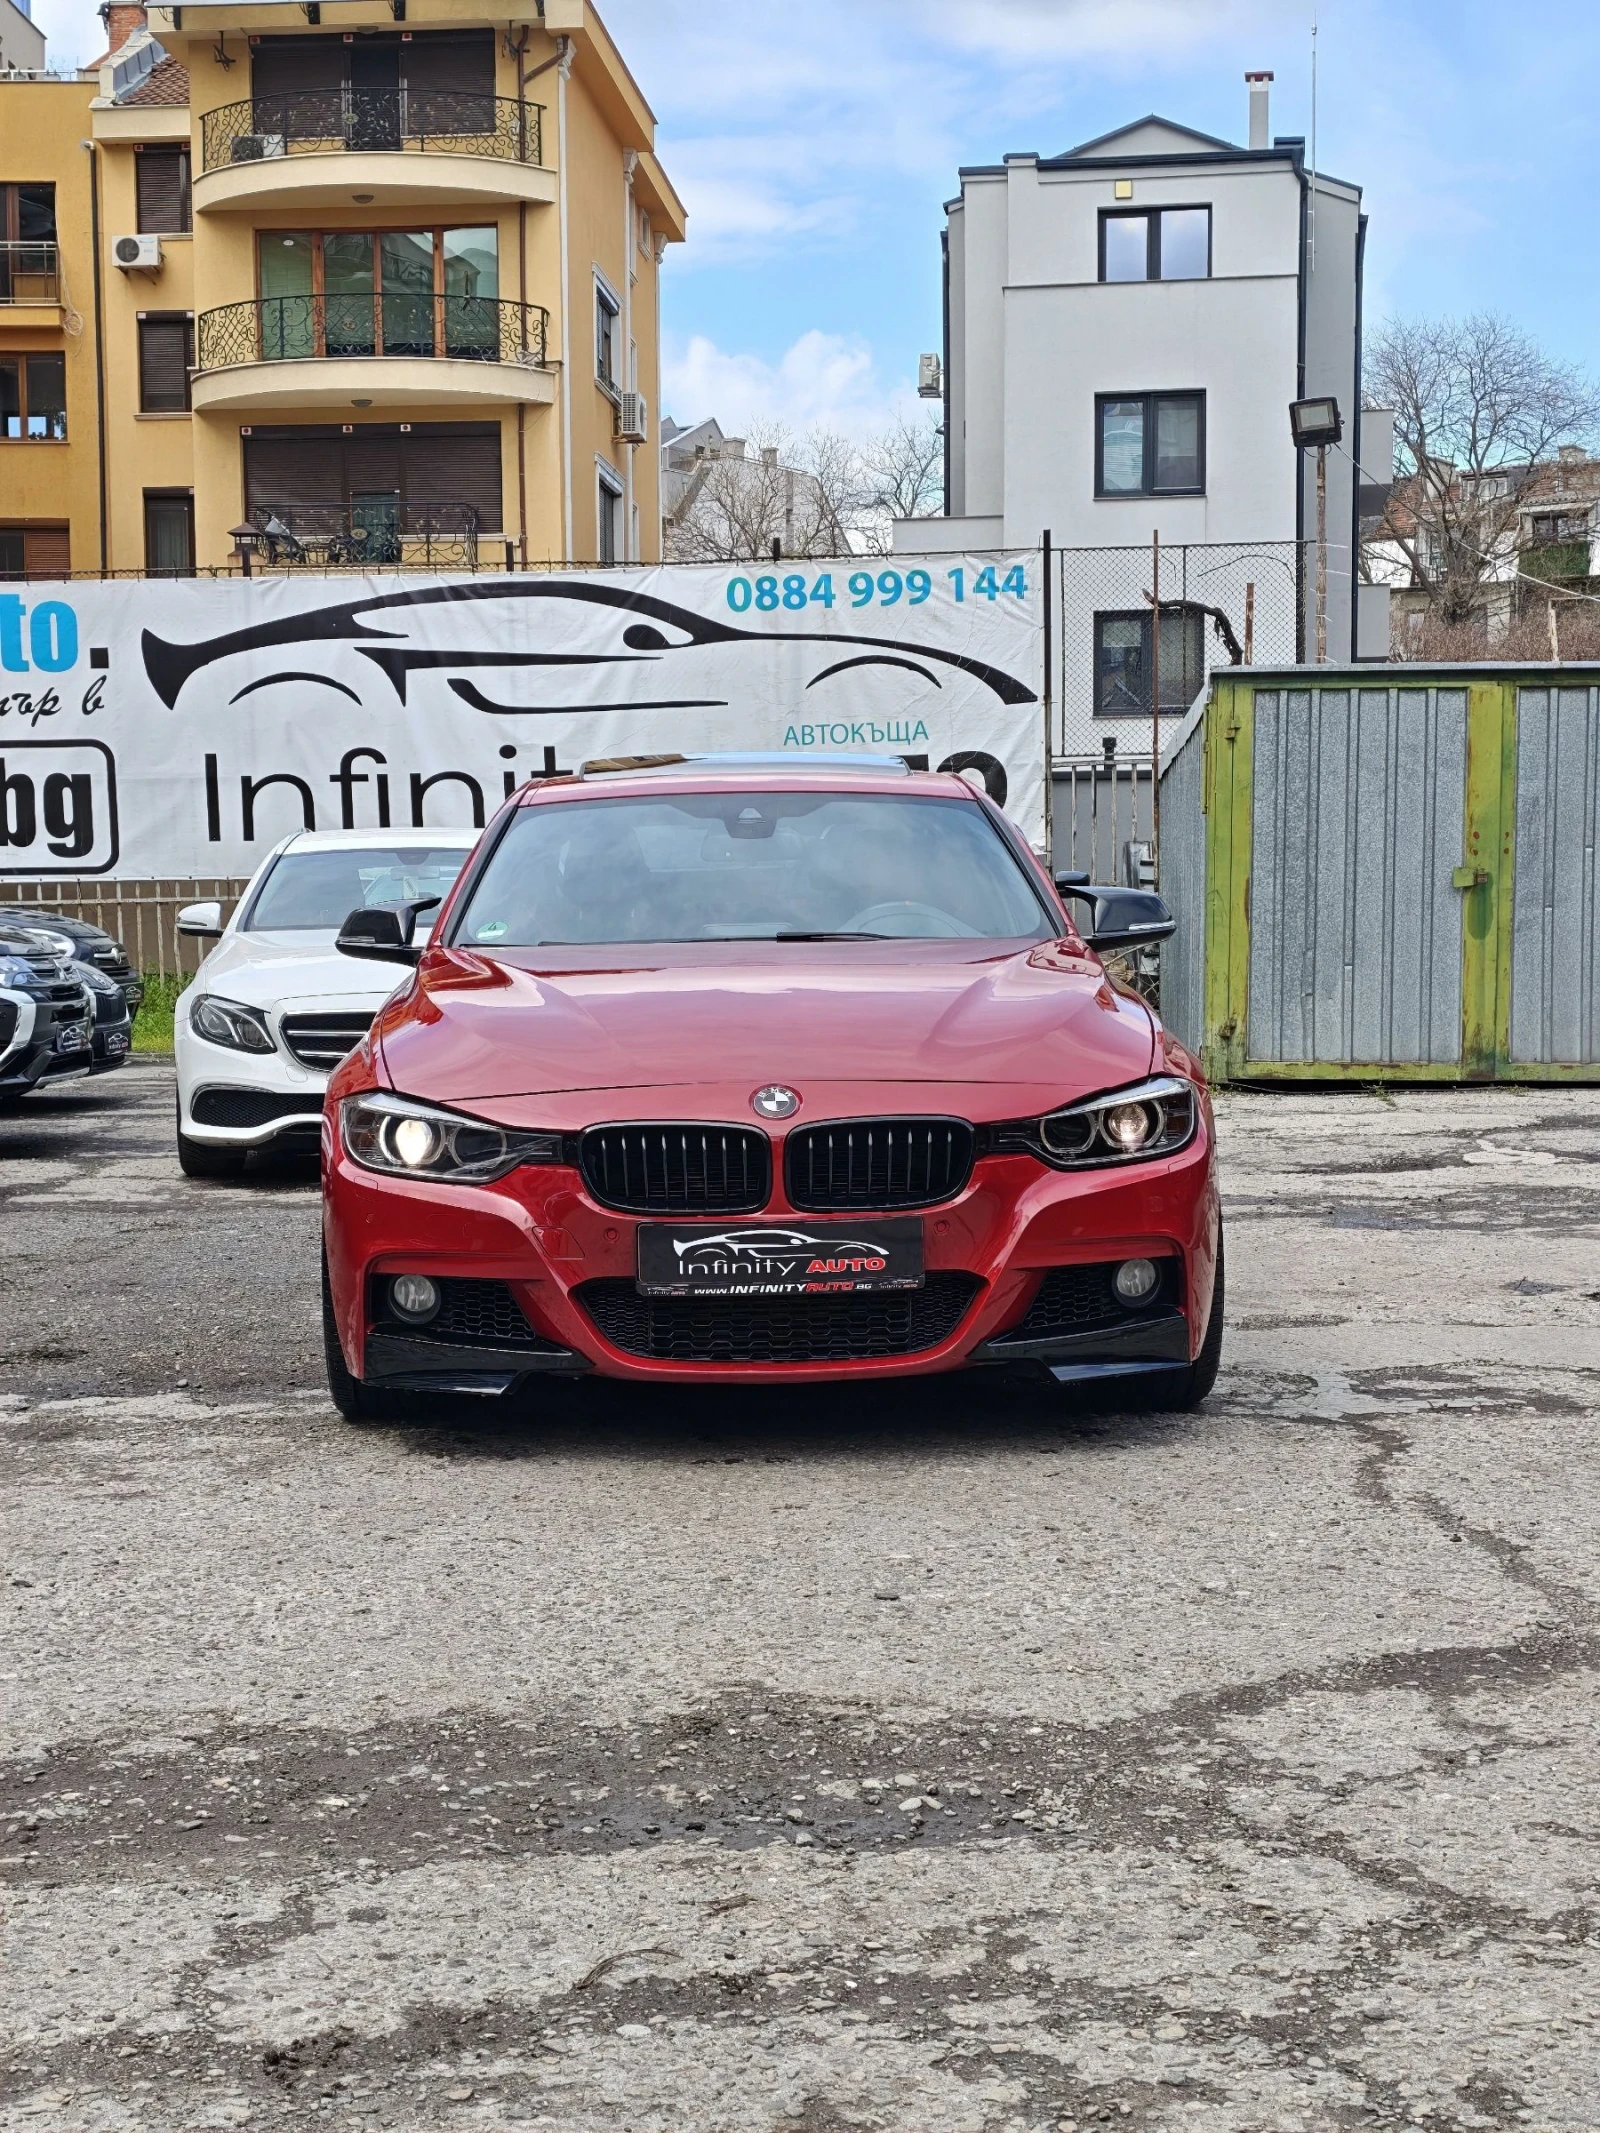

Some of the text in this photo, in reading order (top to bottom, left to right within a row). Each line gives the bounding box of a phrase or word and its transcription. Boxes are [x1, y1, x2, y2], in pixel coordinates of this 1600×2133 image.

[726, 564, 1029, 613] 0884 999 144
[783, 719, 930, 747] АВТОКЪЩА
[757, 1087, 793, 1098] BMW
[679, 1256, 886, 1276] Infinity AUTO
